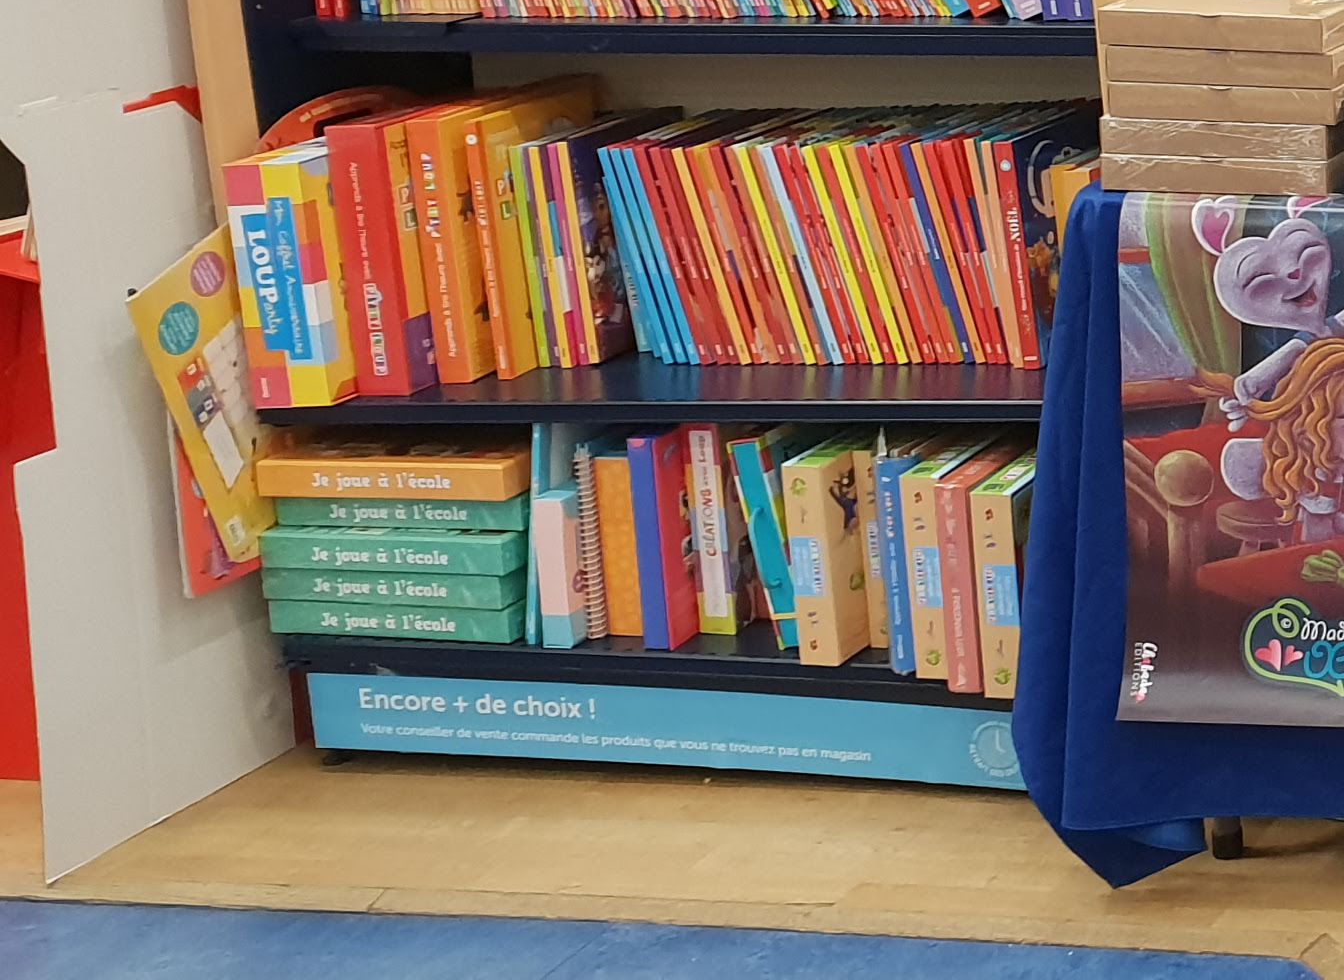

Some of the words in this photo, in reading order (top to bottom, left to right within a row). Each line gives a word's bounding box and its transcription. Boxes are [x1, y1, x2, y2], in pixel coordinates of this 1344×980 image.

[420, 153, 436, 191] LOUP
[311, 473, 328, 487] Je
[336, 473, 371, 491] joue
[378, 473, 389, 487] à
[395, 474, 452, 489] l'école
[329, 505, 347, 519] Je
[353, 504, 388, 522] joue
[395, 504, 406, 519] à
[413, 505, 468, 521] l'école
[705, 489, 718, 557] CRÉATIONS
[311, 547, 328, 561] Je
[335, 546, 369, 566] joue
[376, 548, 388, 563] à
[393, 548, 449, 565] l'école
[312, 578, 331, 593] Je
[336, 577, 370, 596] joue
[376, 579, 388, 594] à
[394, 580, 447, 597] l'école
[320, 613, 338, 627] Je
[344, 613, 378, 631] joue
[386, 614, 396, 629] à
[402, 615, 456, 632] l'école
[1130, 642, 1142, 697] EDITIONS
[358, 688, 447, 712] Encore
[453, 696, 469, 713] +
[475, 693, 507, 715] de
[513, 695, 582, 718] choix
[589, 698, 596, 720] !
[360, 723, 393, 735] Votre
[396, 724, 455, 738] conseiller
[456, 727, 472, 739] de
[474, 729, 508, 741] vente
[511, 730, 579, 744] commande
[581, 732, 599, 745] les
[601, 736, 652, 750] produits
[654, 739, 677, 752] que
[679, 740, 709, 751] vous
[711, 742, 727, 752] ne
[729, 743, 775, 755] trouvez
[777, 746, 799, 758] pas
[801, 747, 817, 758] en
[820, 749, 872, 763] magasin
